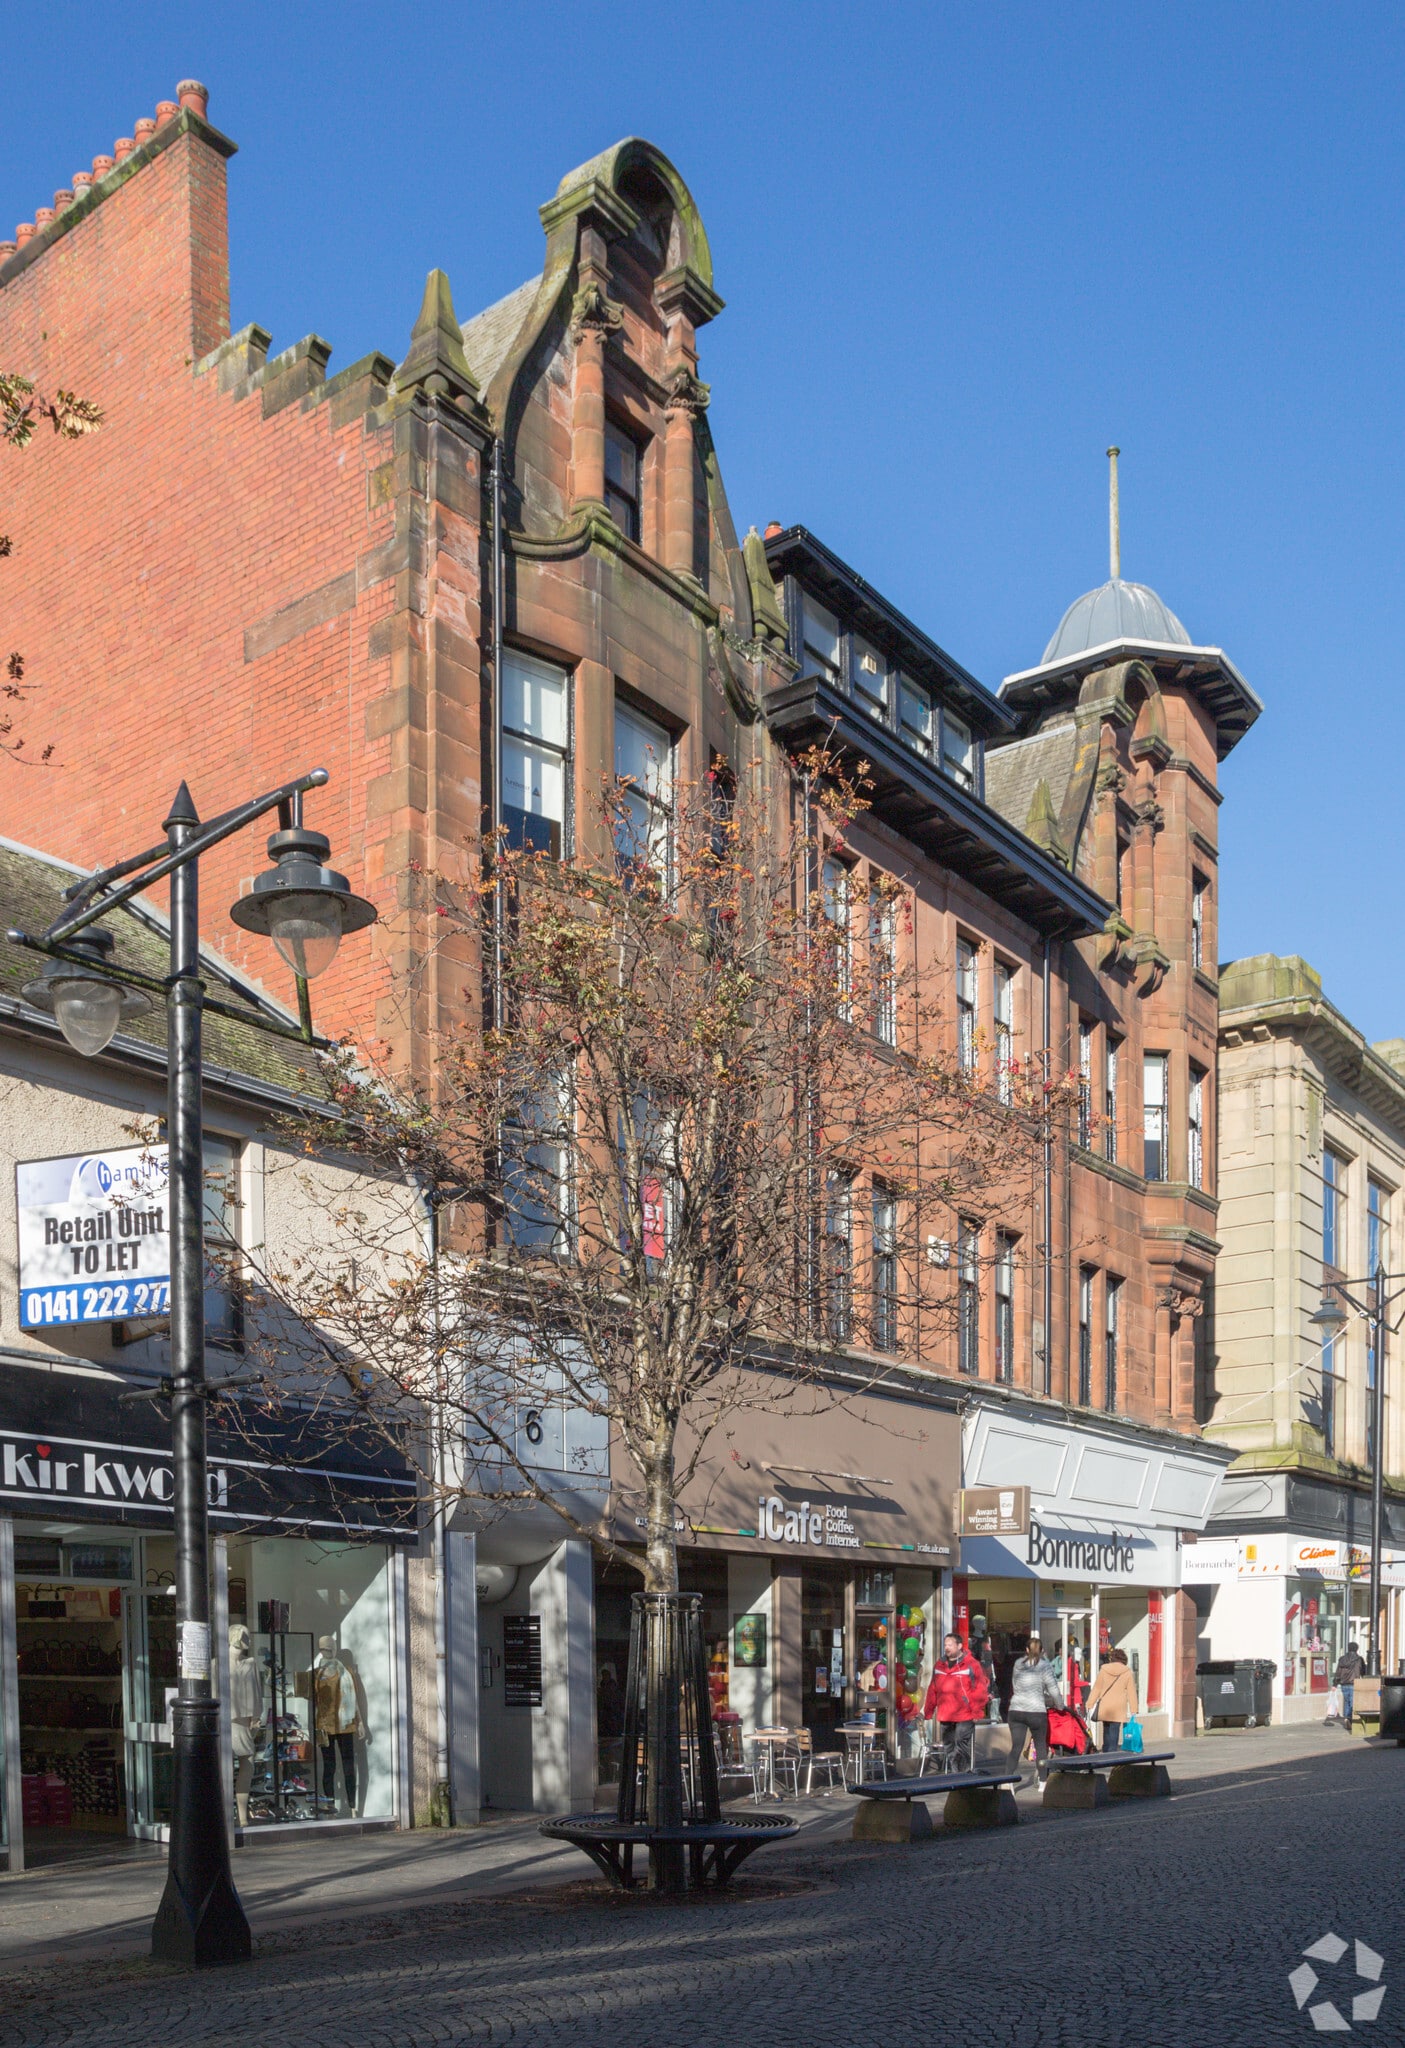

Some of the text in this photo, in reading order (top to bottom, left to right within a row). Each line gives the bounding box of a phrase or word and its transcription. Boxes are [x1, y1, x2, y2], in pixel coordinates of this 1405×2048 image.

[645, 1203, 662, 1220] ET
[45, 1206, 164, 1245] Retail Unit
[71, 1241, 141, 1275] TO LET
[27, 1282, 171, 1324] 0141 222 277
[526, 1410, 542, 1444] 6
[4, 1444, 228, 1507] kirkwod
[759, 1496, 822, 1545] iCafe
[826, 1505, 847, 1518] Food
[968, 1516, 997, 1524] Winning
[976, 1508, 997, 1516] Award
[826, 1519, 854, 1533] Coffee
[826, 1533, 860, 1547] Internet
[1026, 1521, 1134, 1573] Bonmarché
[1148, 1612, 1163, 1623] SALE
